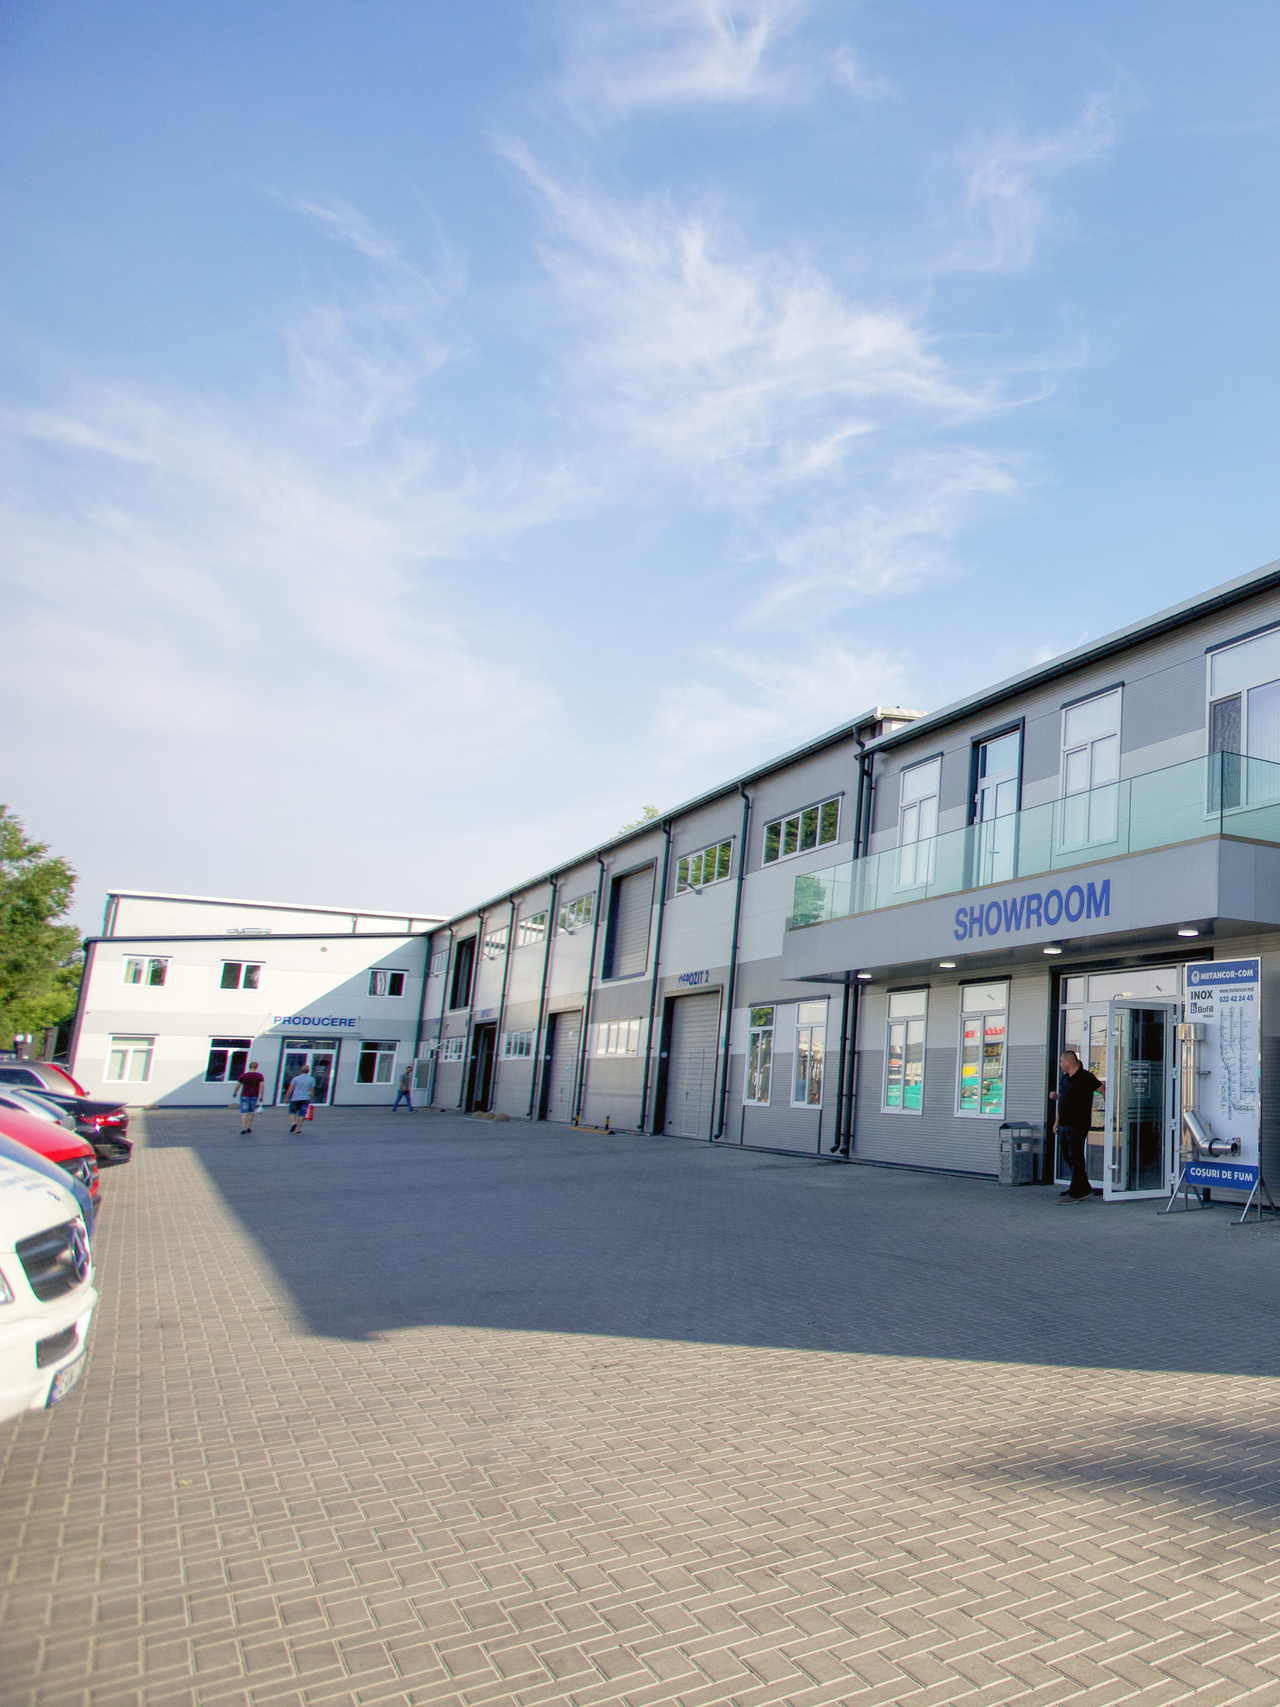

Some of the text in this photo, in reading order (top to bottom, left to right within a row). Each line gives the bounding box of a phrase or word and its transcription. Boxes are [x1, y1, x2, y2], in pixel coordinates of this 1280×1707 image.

[954, 879, 1111, 941] SHOWROOM
[705, 970, 710, 983] 2
[1200, 969, 1254, 980] METANCOR-COM
[1190, 990, 1213, 1000] INOX
[273, 1016, 357, 1027] PRODUCERE
[1221, 1170, 1232, 1179] DE
[1234, 1171, 1253, 1181] FUM
